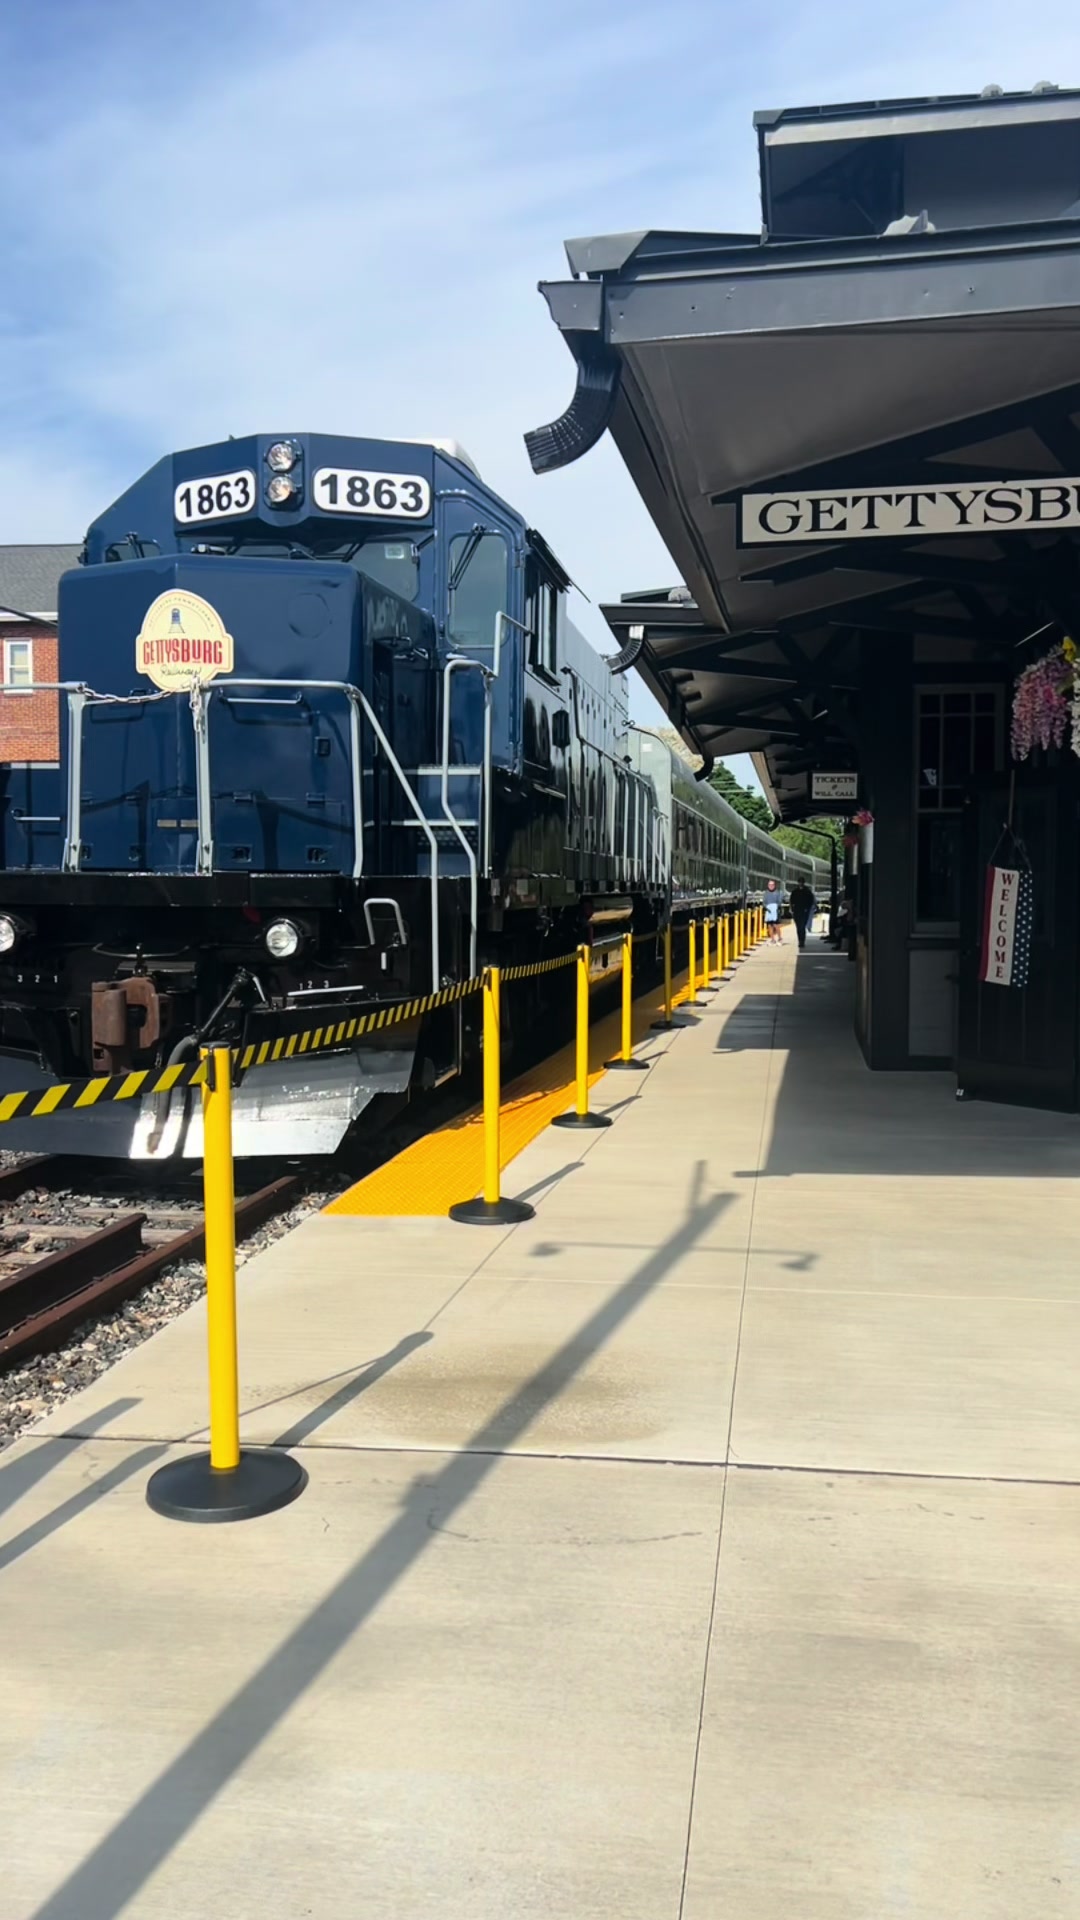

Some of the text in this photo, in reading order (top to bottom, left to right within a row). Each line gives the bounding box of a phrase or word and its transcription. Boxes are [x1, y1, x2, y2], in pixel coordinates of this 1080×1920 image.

[179, 477, 250, 518] 1863
[320, 474, 424, 513] 1863
[143, 638, 223, 665] GETTYSBURG
[995, 873, 1014, 978] WELCOME
